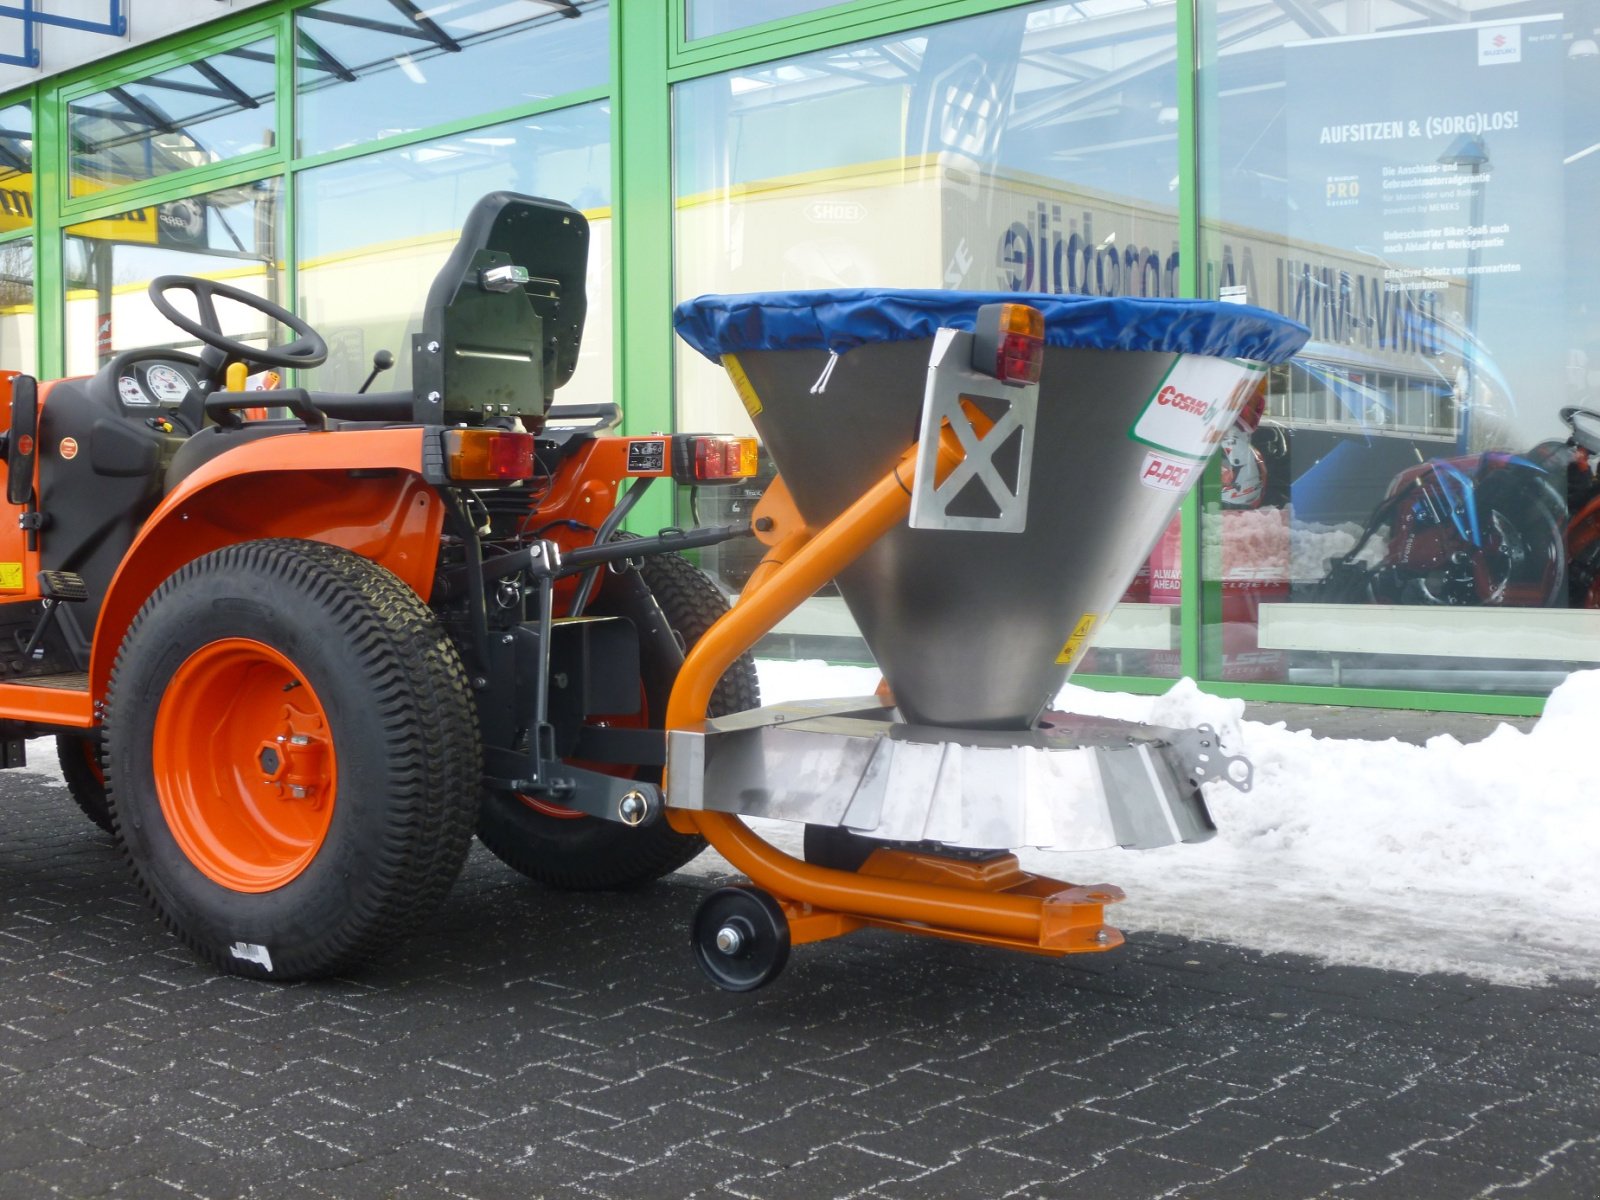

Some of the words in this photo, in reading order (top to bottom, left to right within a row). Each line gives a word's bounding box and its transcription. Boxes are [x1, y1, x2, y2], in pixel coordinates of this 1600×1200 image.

[1320, 121, 1403, 144] AUFSITZEN
[1408, 120, 1421, 137] &
[1426, 111, 1519, 139] (SORG)LOS!
[1382, 167, 1396, 176] Die
[1442, 162, 1458, 172] und
[1326, 181, 1359, 199] PRO
[813, 203, 859, 220] SHOEI
[1383, 228, 1442, 241] Unbeschwerter
[1490, 223, 1510, 234] auch
[1383, 243, 1404, 253] nach
[1432, 240, 1446, 250] der
[1446, 237, 1505, 250] Werksgarantie
[1423, 266, 1450, 277] Schutz
[1452, 266, 1466, 275] vor
[1467, 263, 1521, 274] unerwarteten
[1153, 569, 1182, 580] ALWAY
[1153, 579, 1180, 590] AHEAD
